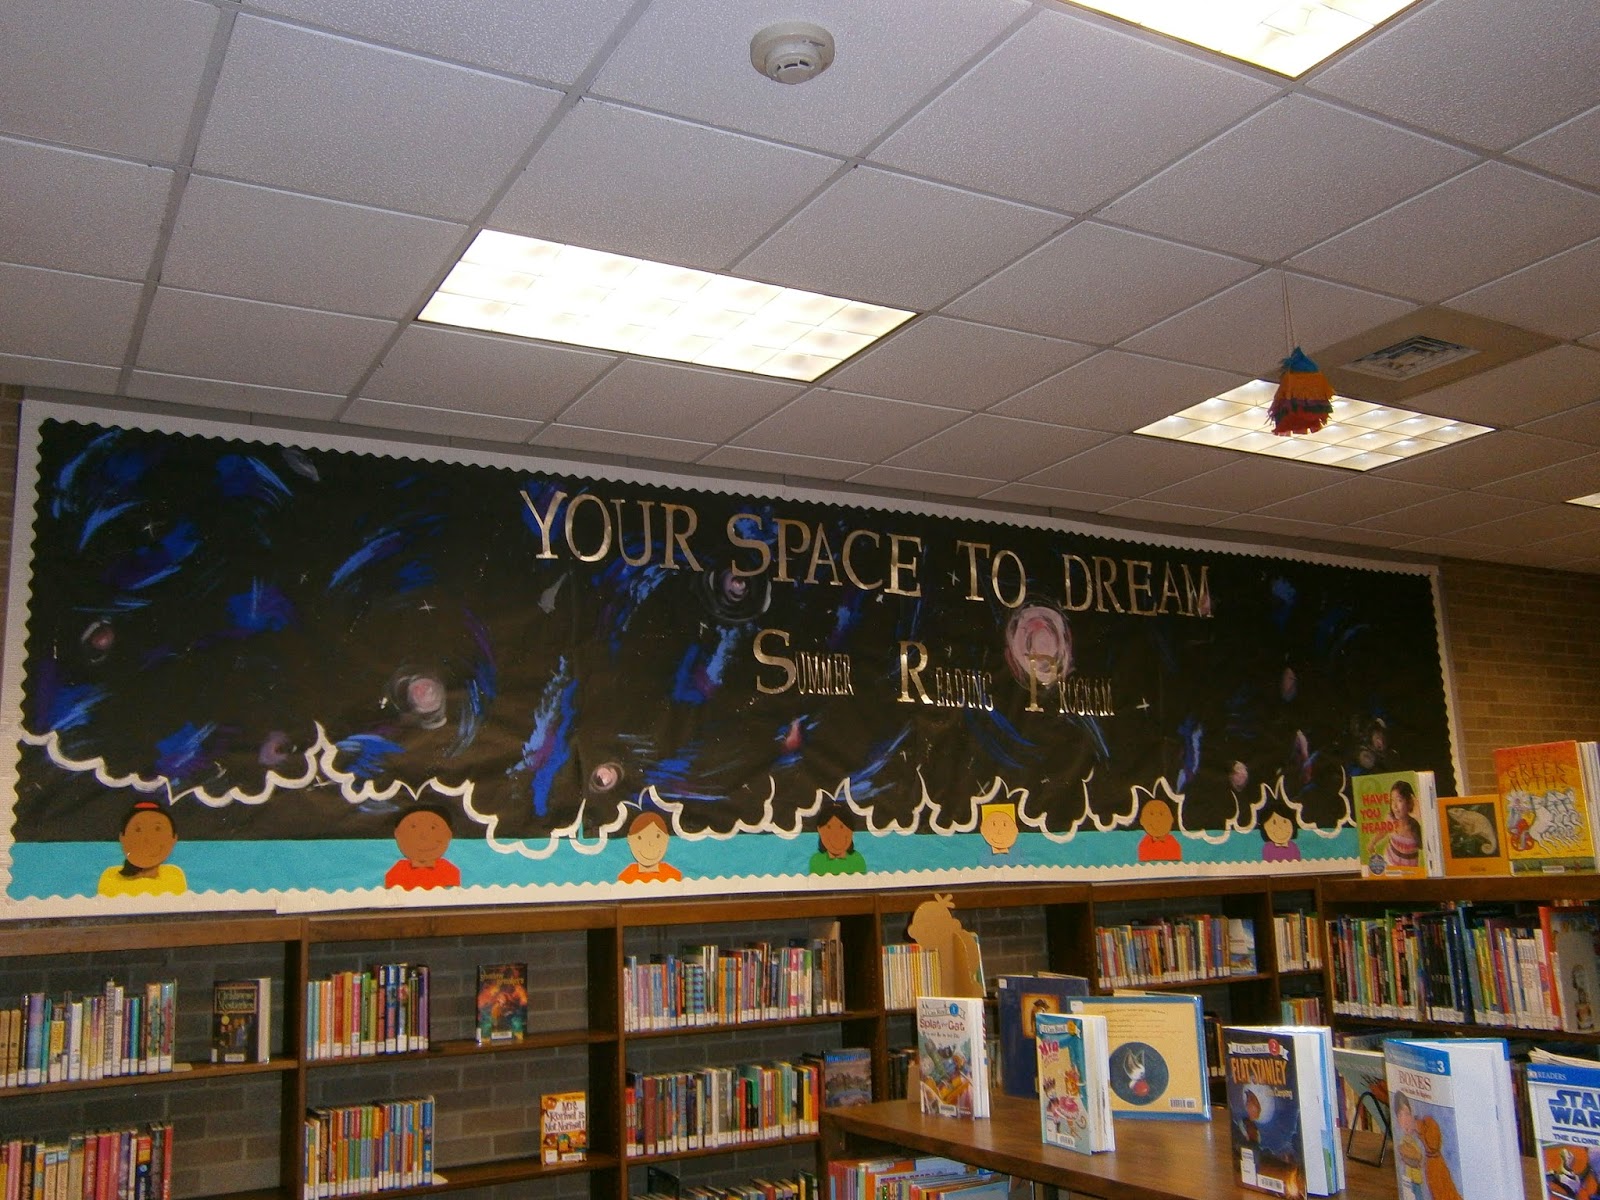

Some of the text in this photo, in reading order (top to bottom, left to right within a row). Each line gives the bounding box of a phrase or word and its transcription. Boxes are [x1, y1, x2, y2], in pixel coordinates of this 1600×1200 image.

[520, 490, 1214, 618] YOUR SPACE TO DREAM
[753, 629, 854, 696] SUMMER
[897, 641, 994, 712] READING
[1507, 761, 1566, 778] GREEK
[1510, 774, 1568, 792] MYTHS
[1362, 793, 1390, 805] HAVE
[1360, 808, 1381, 819] YOU
[1361, 820, 1399, 833] HEARD?
[920, 1018, 941, 1029] Splat
[1231, 1057, 1287, 1086] FLAT STANLEY
[1436, 1060, 1446, 1073] 3
[1398, 1070, 1431, 1091] BONES
[1538, 1071, 1567, 1080] READERS
[1548, 1090, 1600, 1110] STA
